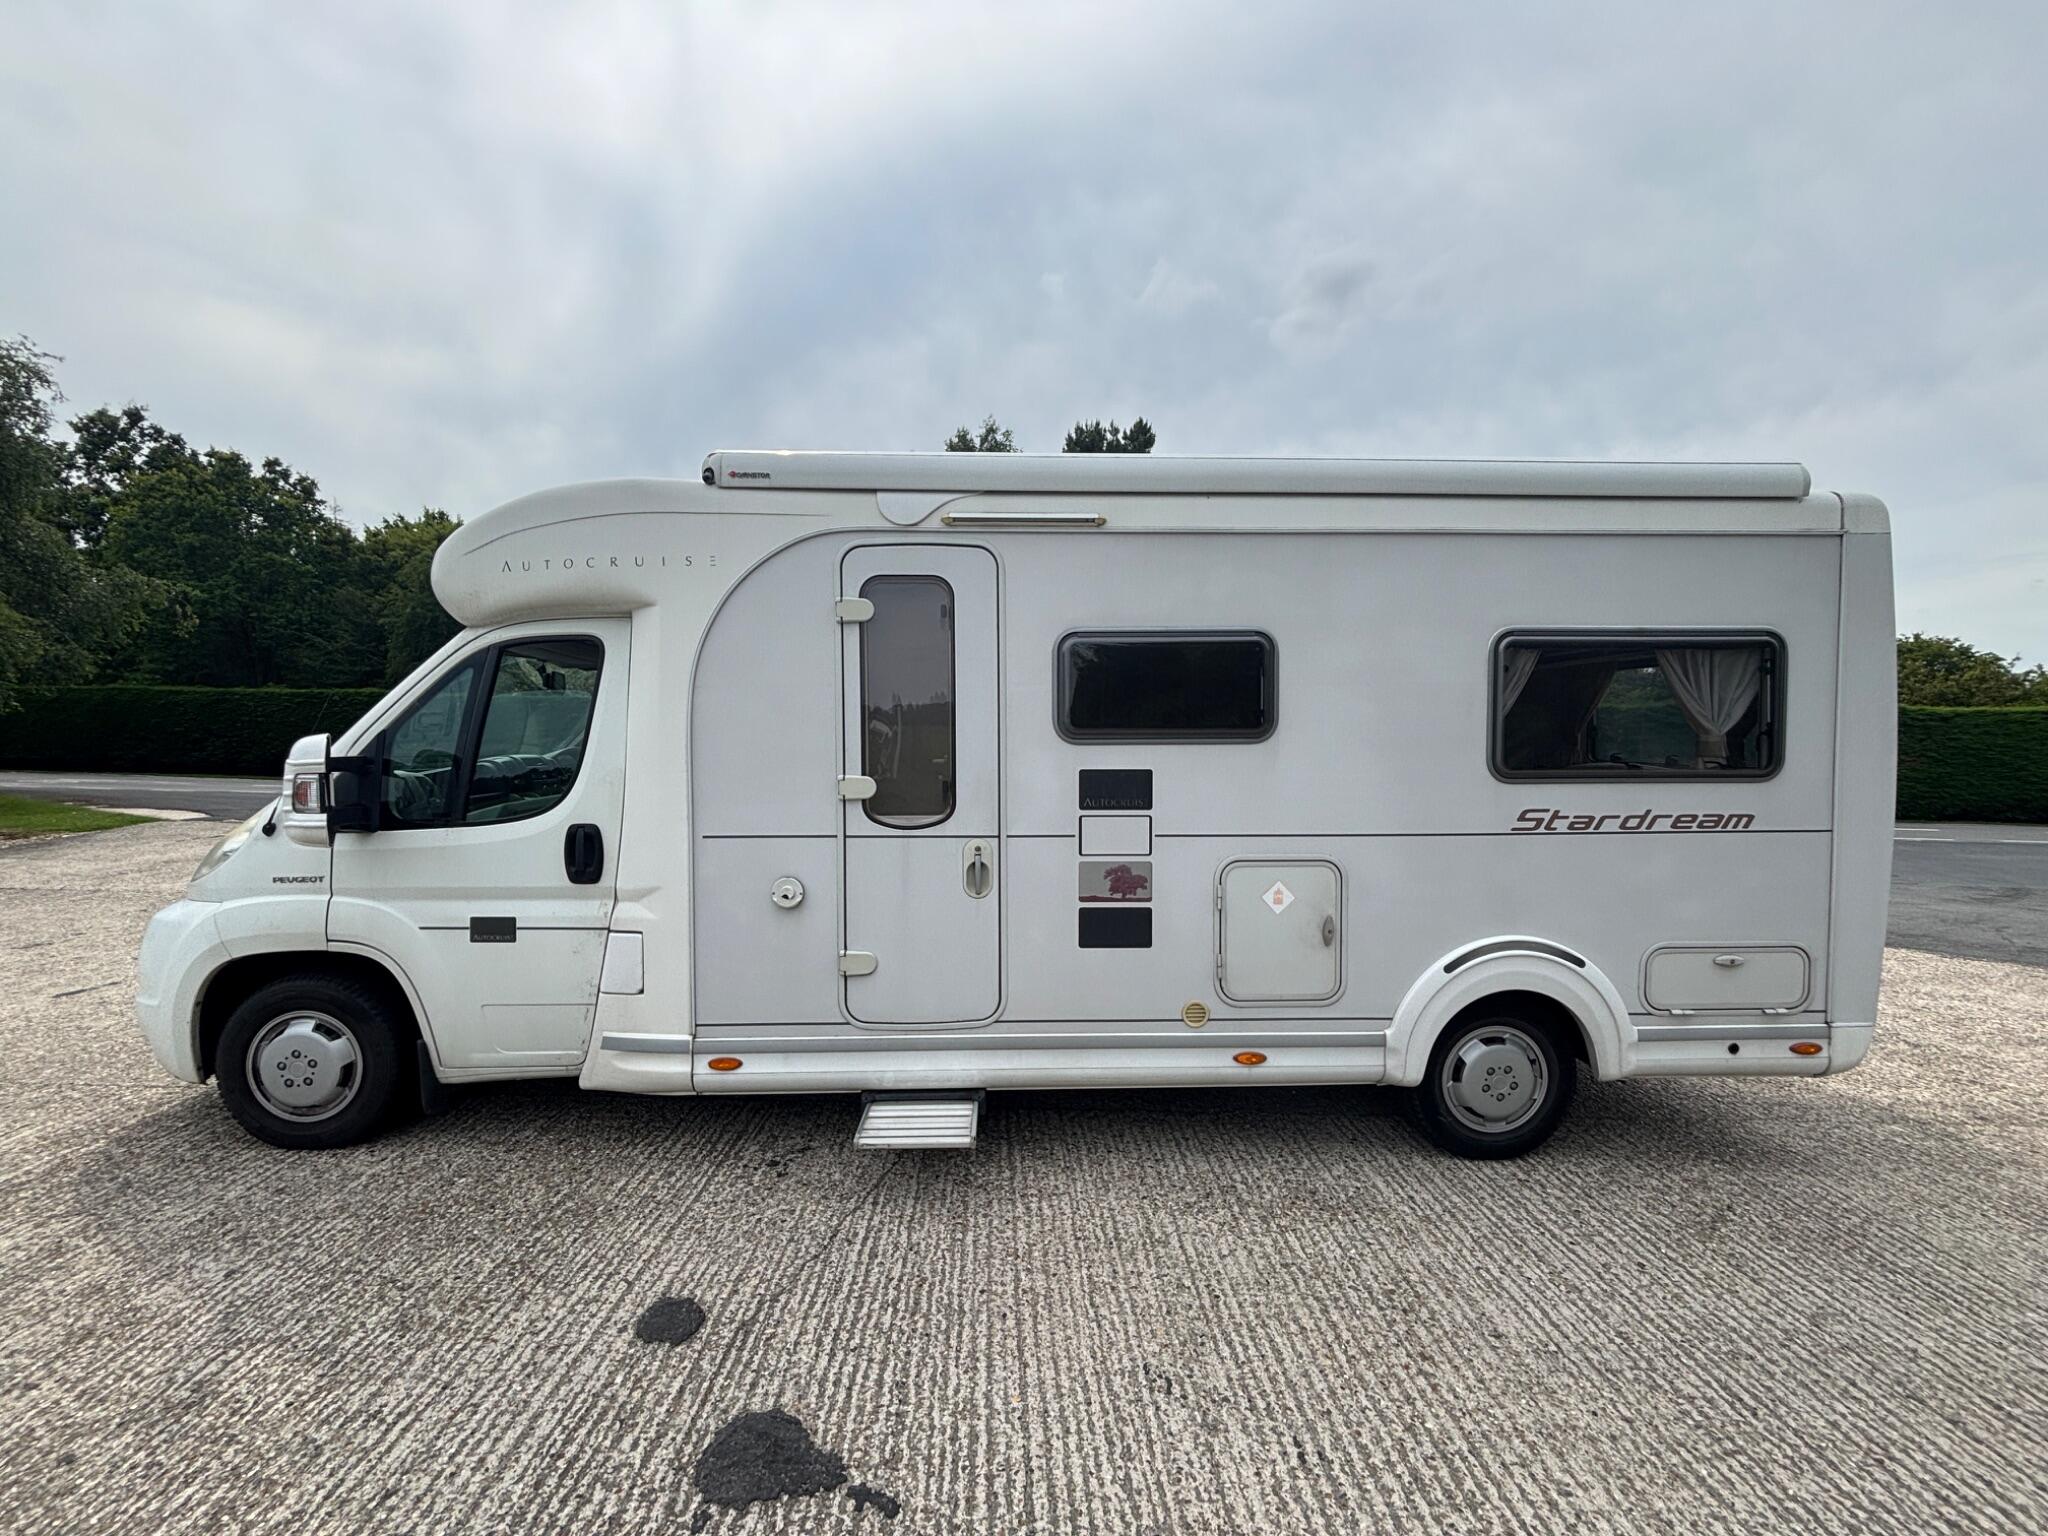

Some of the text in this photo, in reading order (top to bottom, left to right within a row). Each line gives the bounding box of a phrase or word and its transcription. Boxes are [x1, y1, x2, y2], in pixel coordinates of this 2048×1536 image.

[501, 555, 716, 573] AUTOCRUISE
[1083, 797, 1149, 808] AUTOCRUIS
[1510, 808, 1756, 832] Stardream
[272, 875, 325, 884] PEUGEOT
